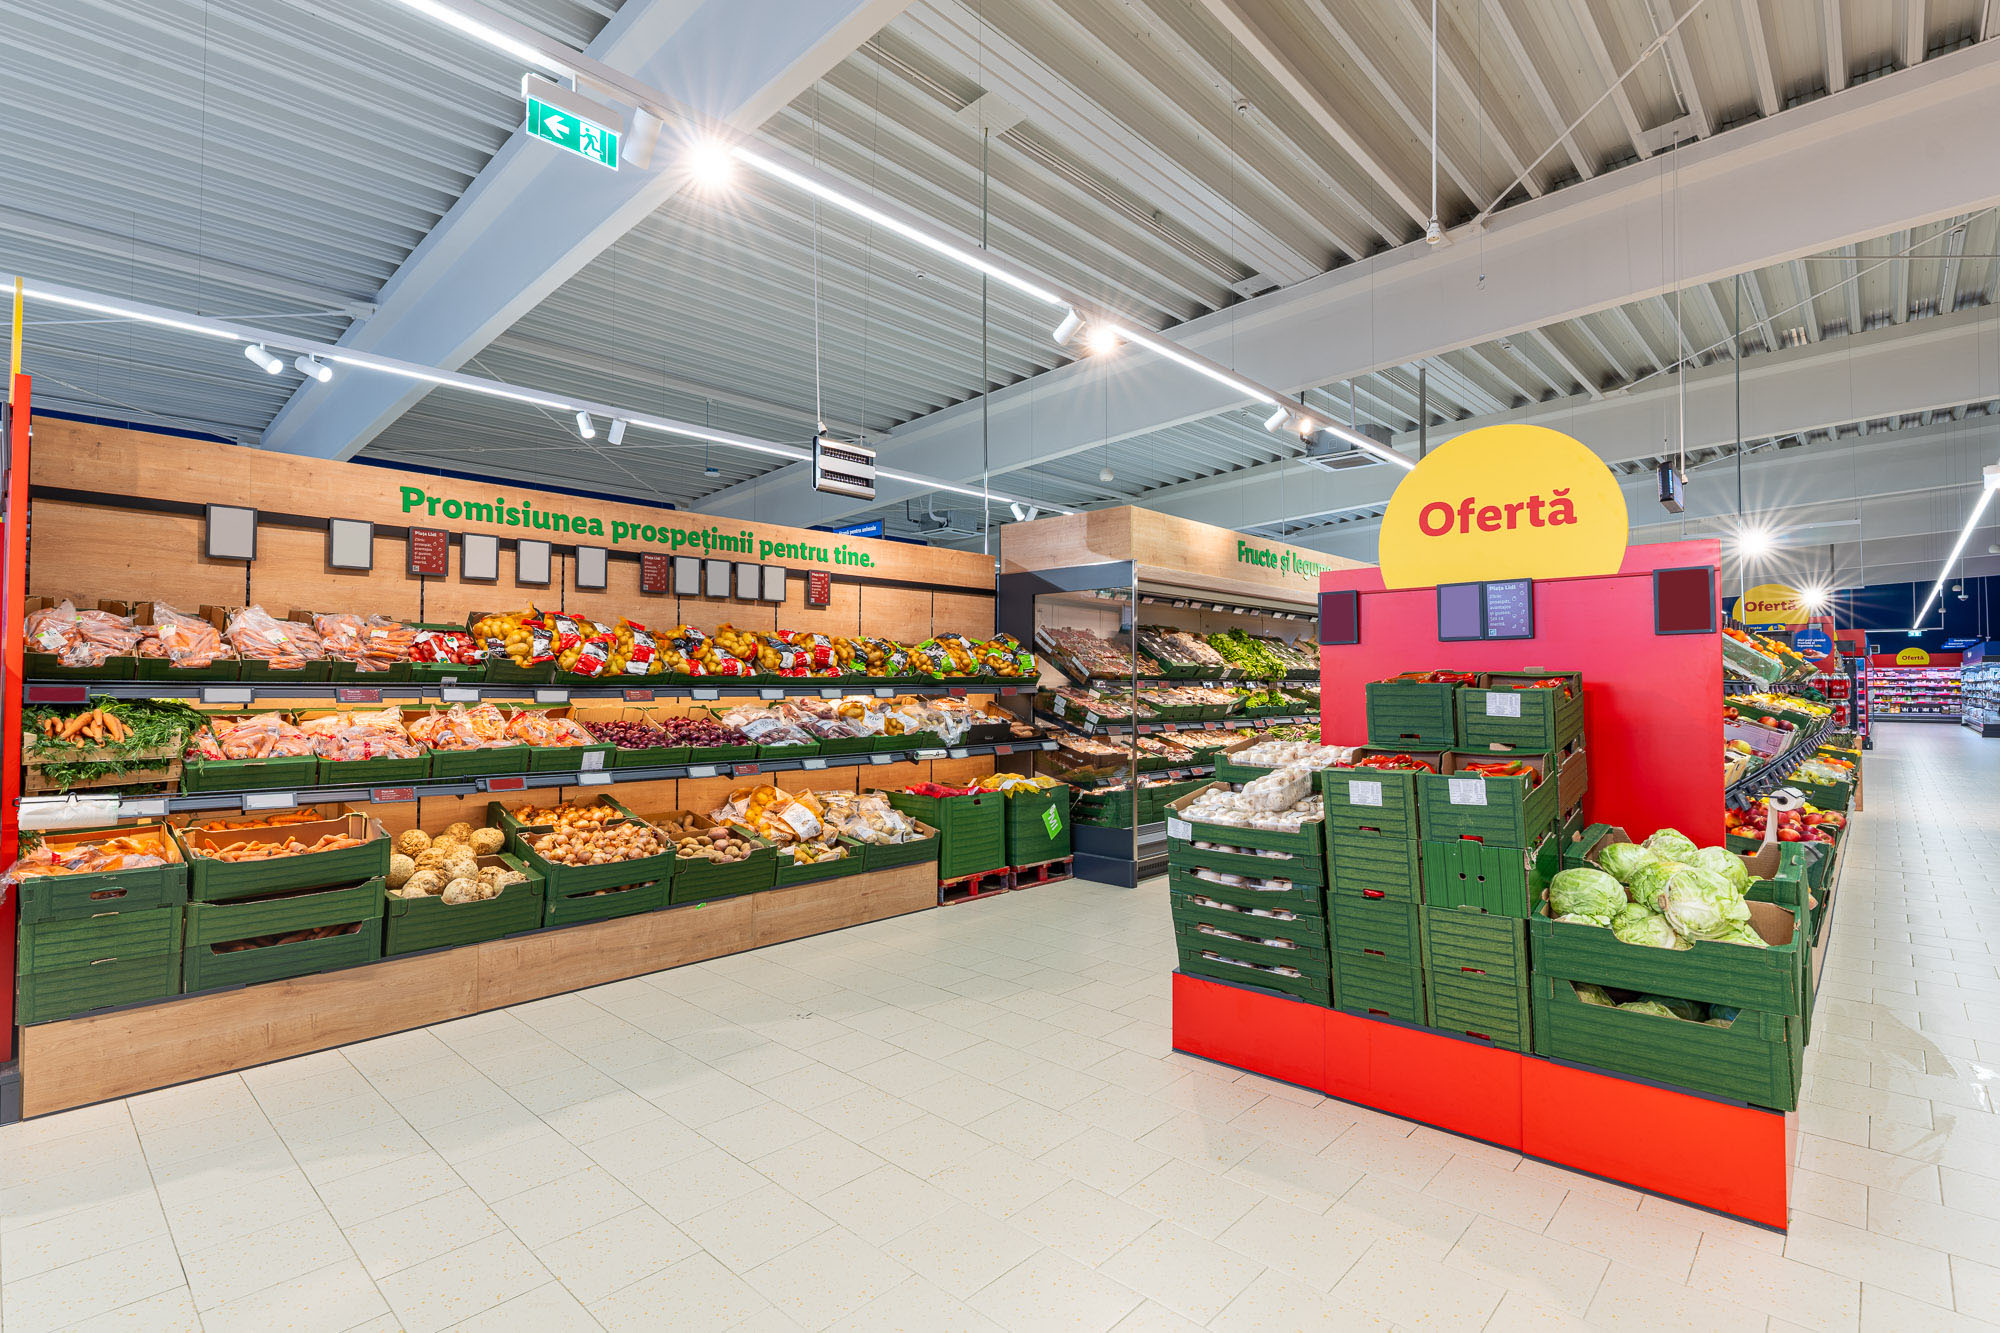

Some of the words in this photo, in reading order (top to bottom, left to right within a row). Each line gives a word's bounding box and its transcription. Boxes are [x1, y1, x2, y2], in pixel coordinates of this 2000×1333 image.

[399, 486, 605, 537] Promisiunea
[611, 520, 754, 556] prospețimii
[759, 539, 829, 563] pentru
[833, 544, 876, 568] tine.
[1419, 489, 1578, 538] Ofertă
[1237, 540, 1278, 569] Fructe
[1281, 549, 1291, 578] și
[1745, 600, 1798, 612] Ofertă
